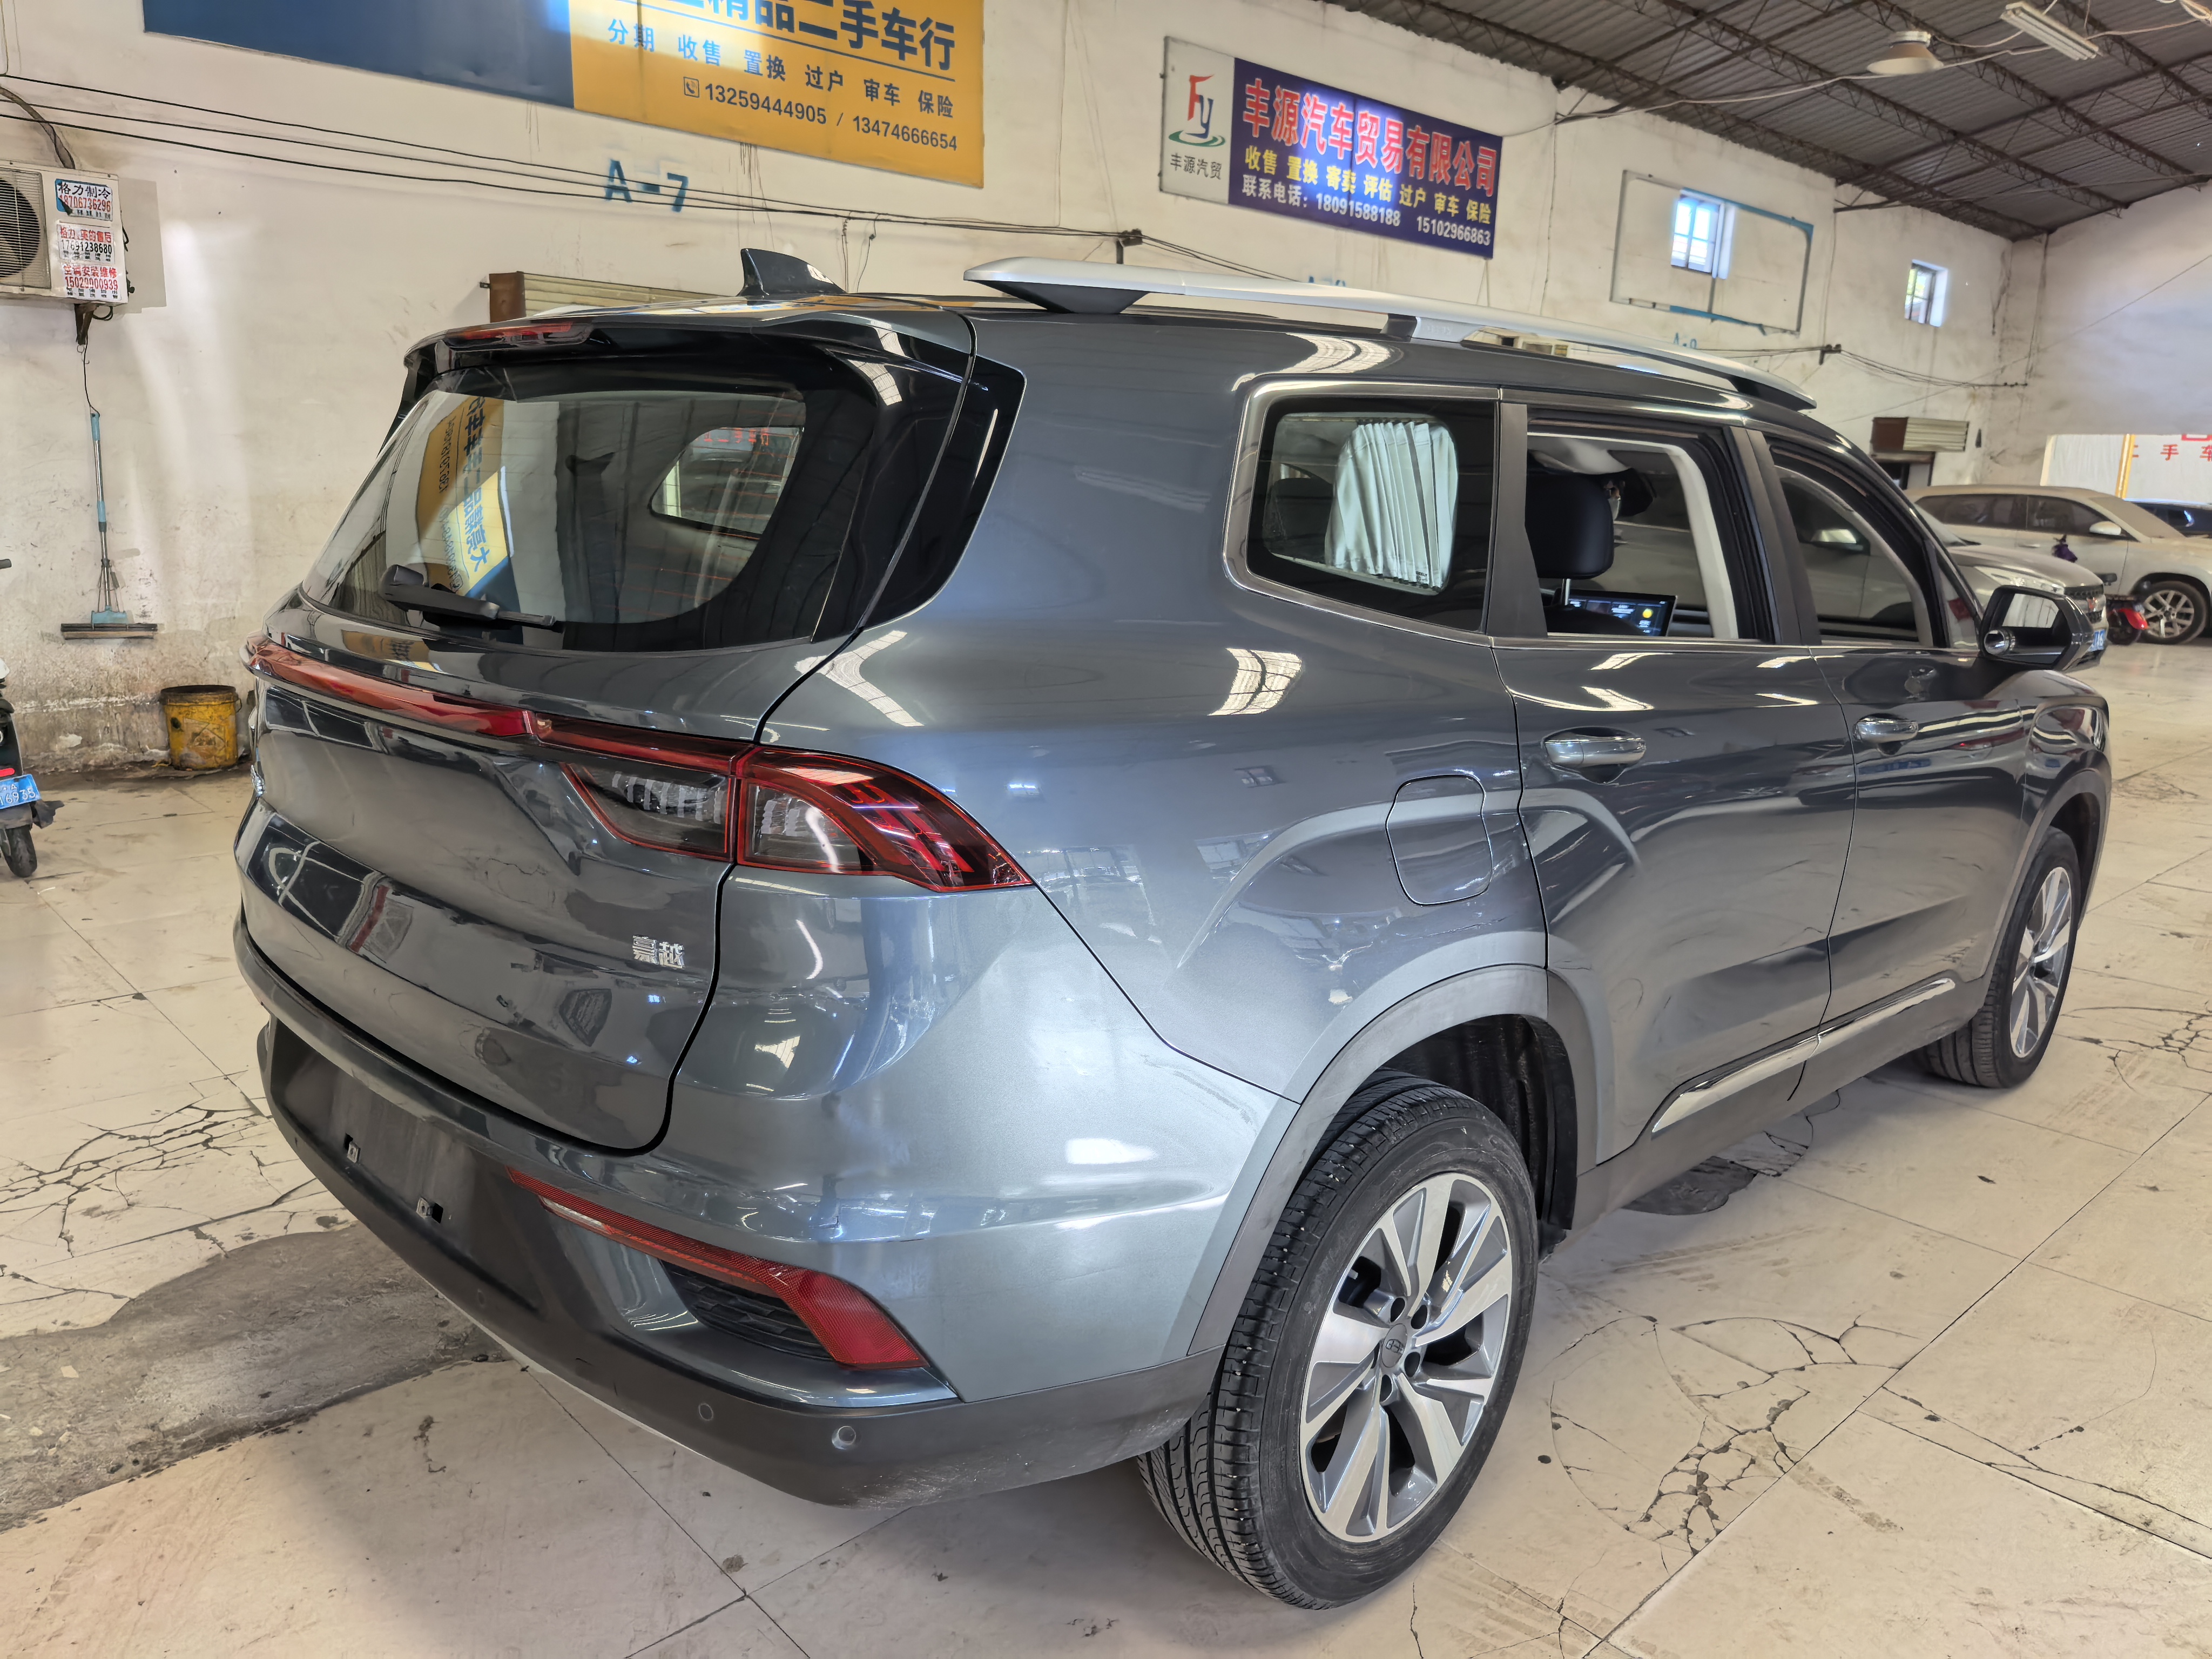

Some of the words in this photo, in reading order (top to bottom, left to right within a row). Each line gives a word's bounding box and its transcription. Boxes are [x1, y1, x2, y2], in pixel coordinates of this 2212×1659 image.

[608, 19, 655, 52] 分期
[678, 34, 721, 66] 收售
[744, 49, 785, 81] 置换
[805, 64, 843, 92] 过户
[864, 78, 900, 106] 审车
[918, 90, 954, 118] 保险
[705, 83, 826, 124] 13259444905
[853, 116, 957, 151] 13474666654
[1243, 78, 1496, 197] 丰源汽车贸易有限公司
[58, 183, 111, 199] 格力制冷
[604, 159, 689, 212] A-7
[1170, 153, 1222, 179] 丰源汽贸
[1245, 145, 1277, 176] 收售
[1287, 156, 1318, 185] 置换
[1326, 165, 1356, 194] 寄卖
[1364, 174, 1393, 202] 评估
[1399, 184, 1426, 208] 过户
[1434, 193, 1460, 217] 审车
[1466, 199, 1491, 224] 保险
[1316, 193, 1401, 226] 18091588188
[1417, 217, 1491, 246] 15102966863
